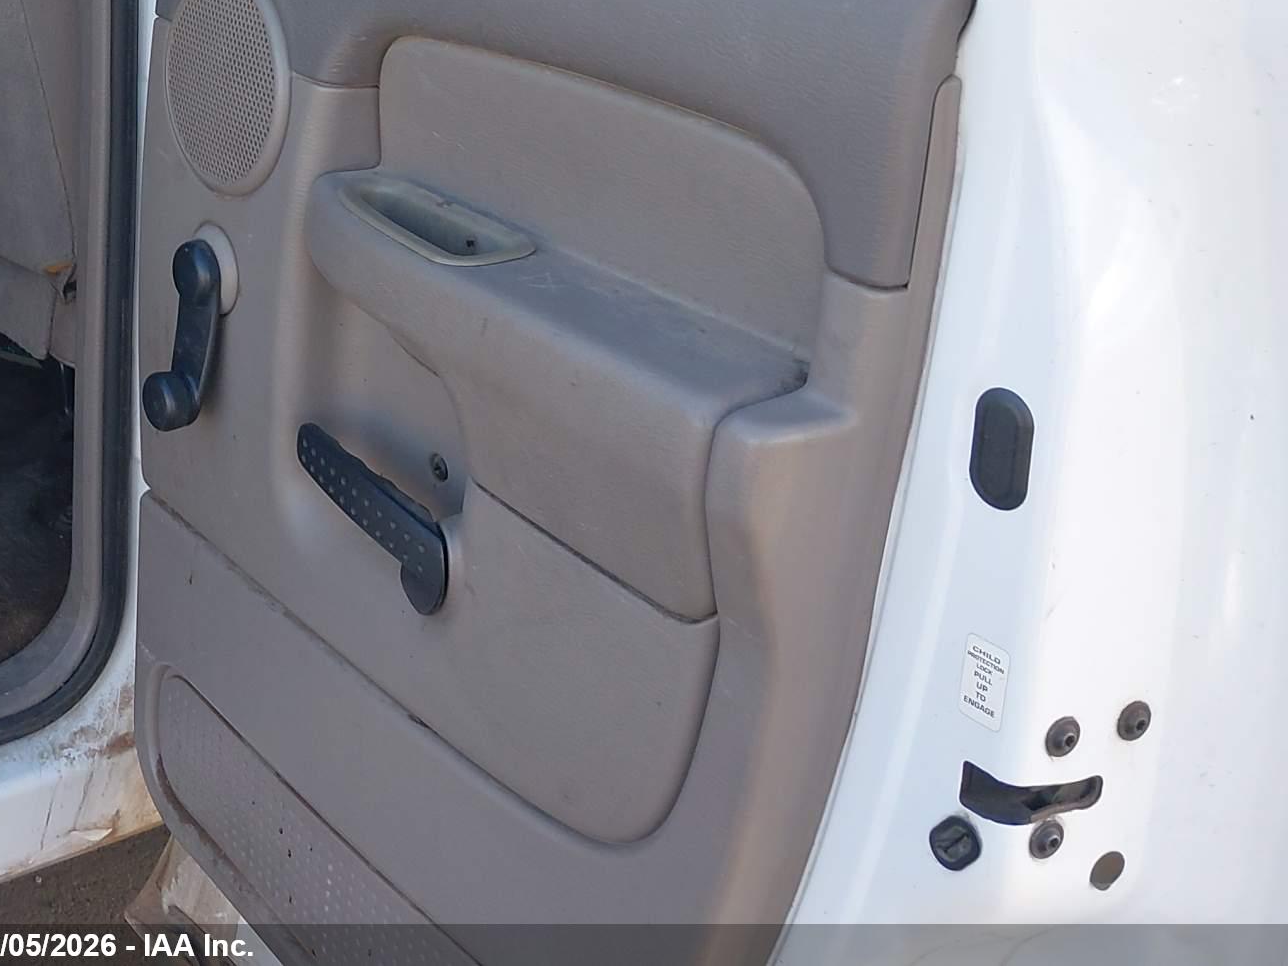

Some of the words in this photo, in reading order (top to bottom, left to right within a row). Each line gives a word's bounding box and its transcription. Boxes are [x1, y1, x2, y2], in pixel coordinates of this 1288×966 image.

[967, 650, 1005, 675] PROTECTION
[972, 645, 1001, 665] CHILD
[976, 663, 993, 676] LOCK
[974, 670, 993, 686] PULL
[976, 681, 988, 692] UP
[975, 690, 987, 703] TO
[963, 695, 995, 719] ENGAGE
